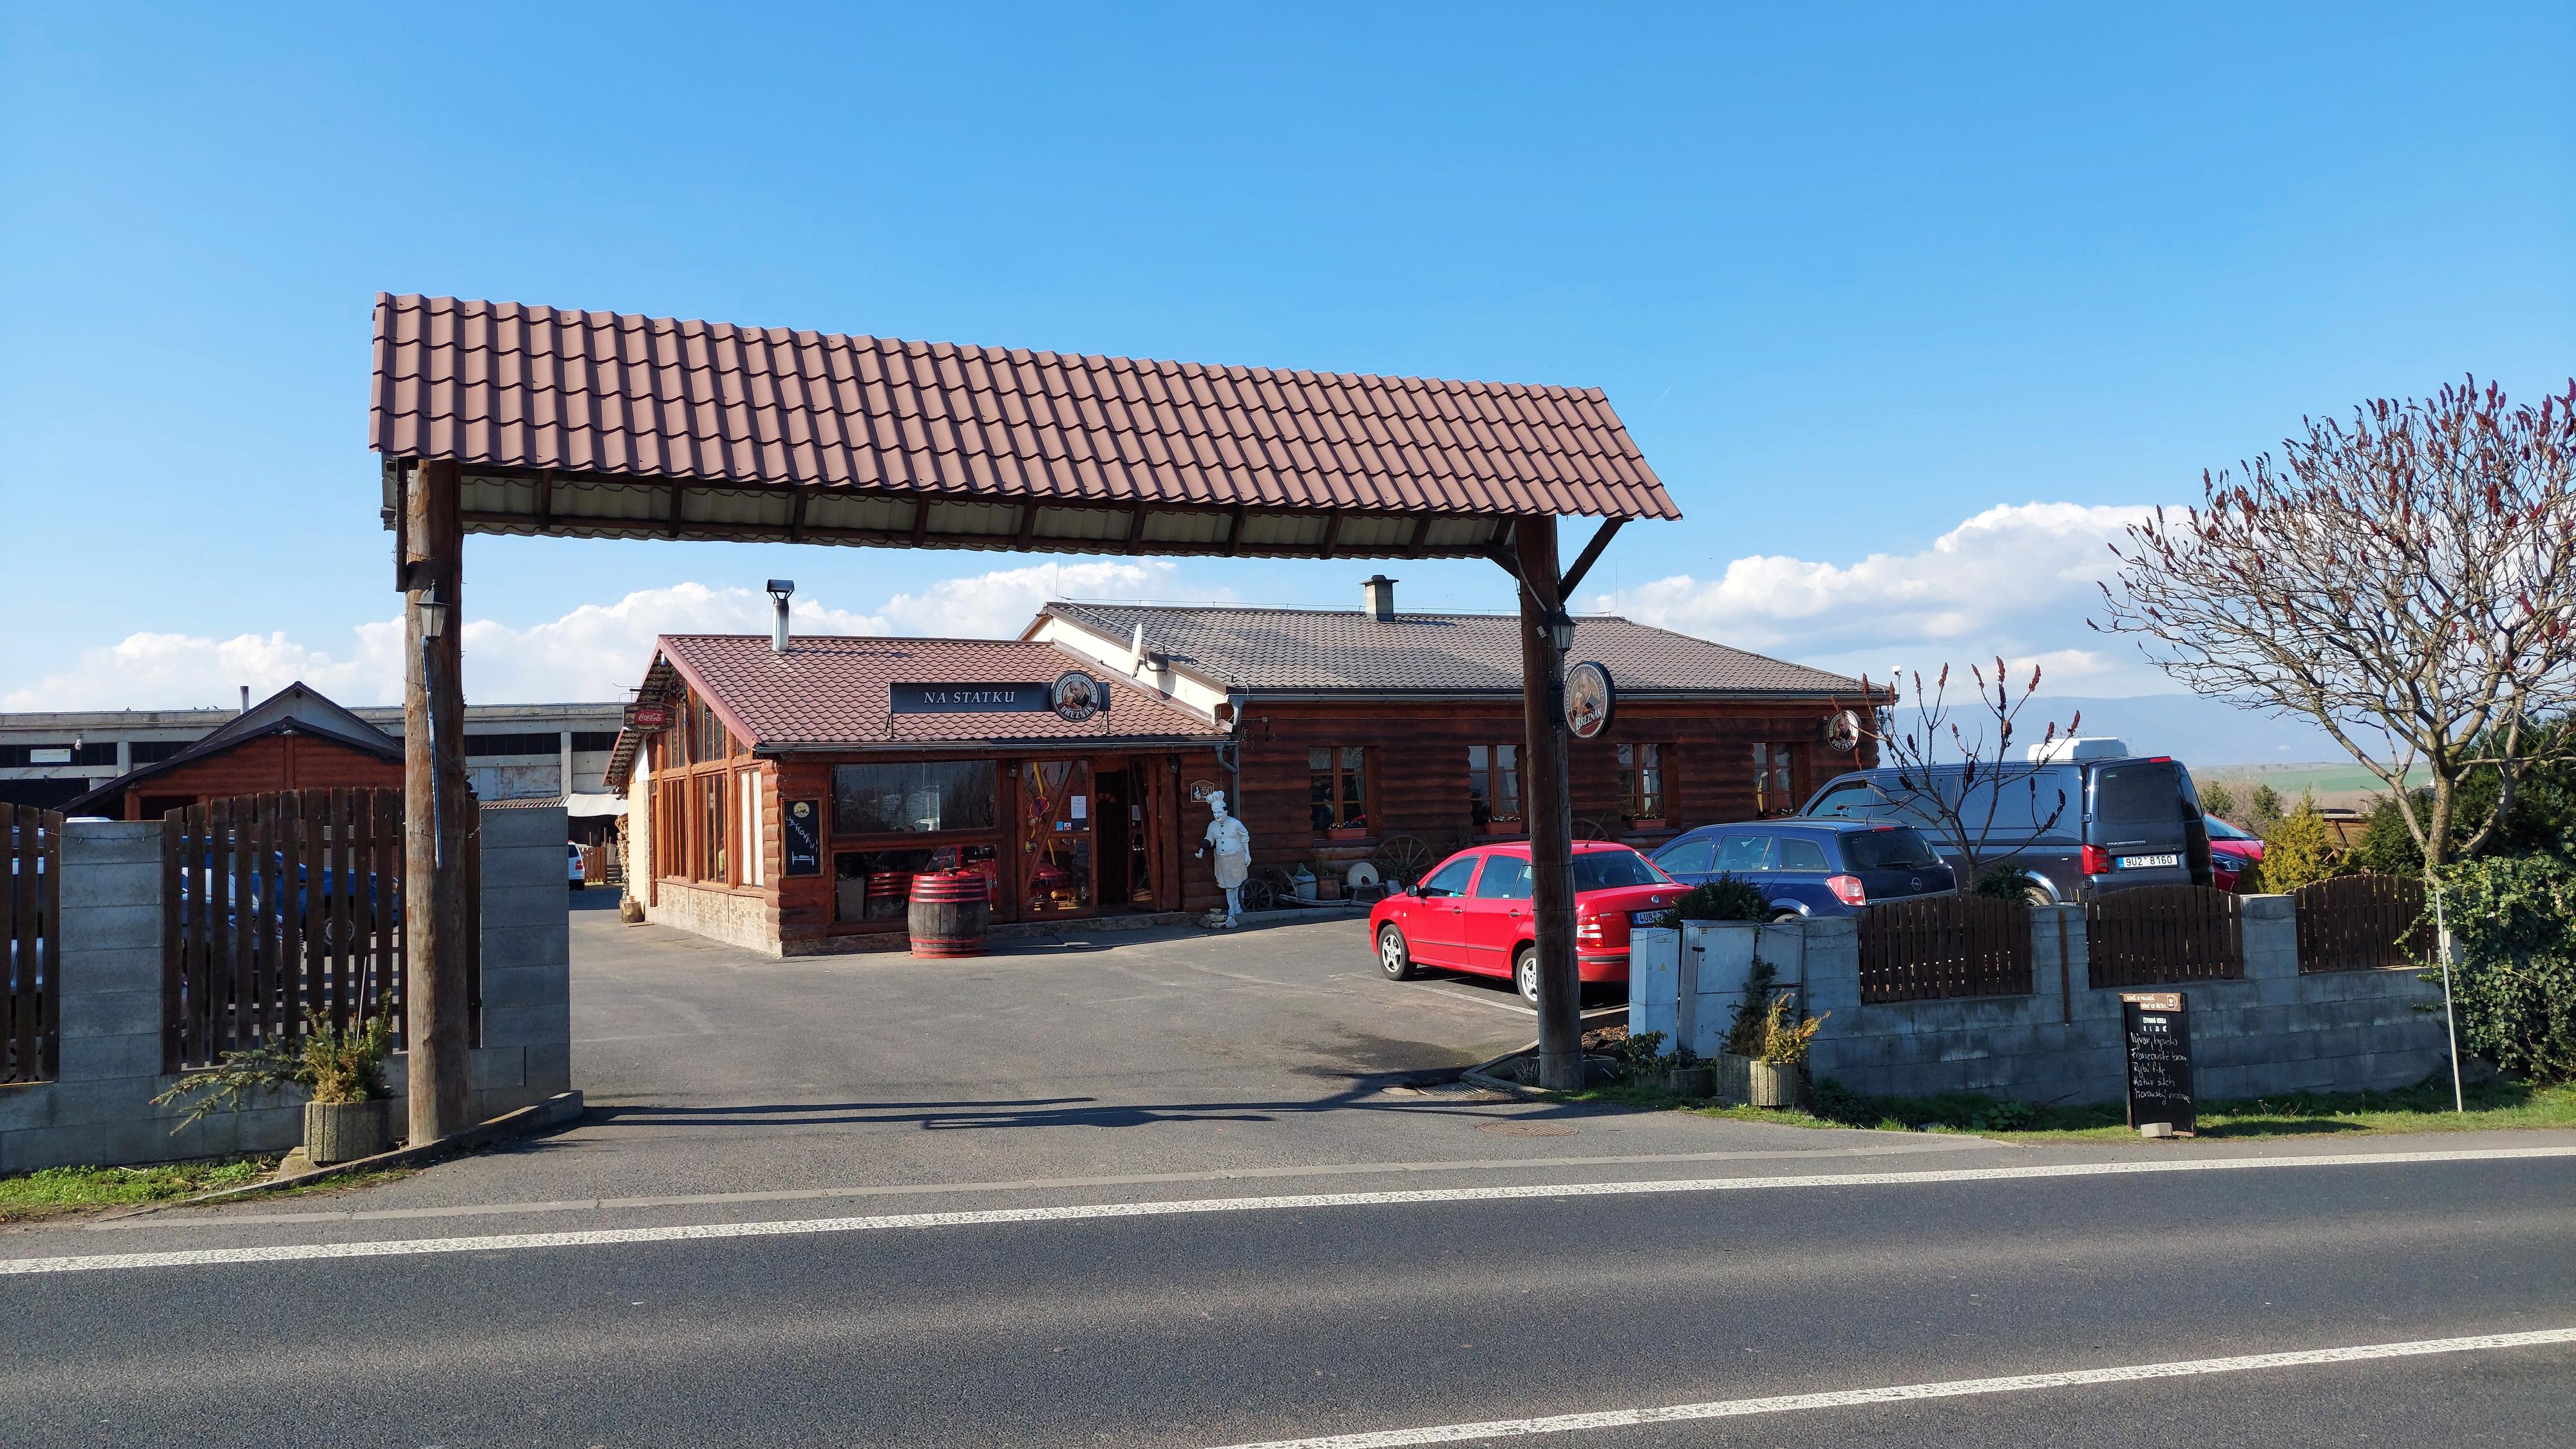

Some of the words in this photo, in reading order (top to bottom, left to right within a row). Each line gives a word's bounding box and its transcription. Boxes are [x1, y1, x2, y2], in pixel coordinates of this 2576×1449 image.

[923, 692, 947, 703] NA
[953, 691, 1016, 703] STATKU
[1202, 786, 1212, 795] 50
[2126, 858, 2143, 866] 9U2
[2150, 856, 2172, 865] 8160
[1640, 913, 1653, 922] 4U8
